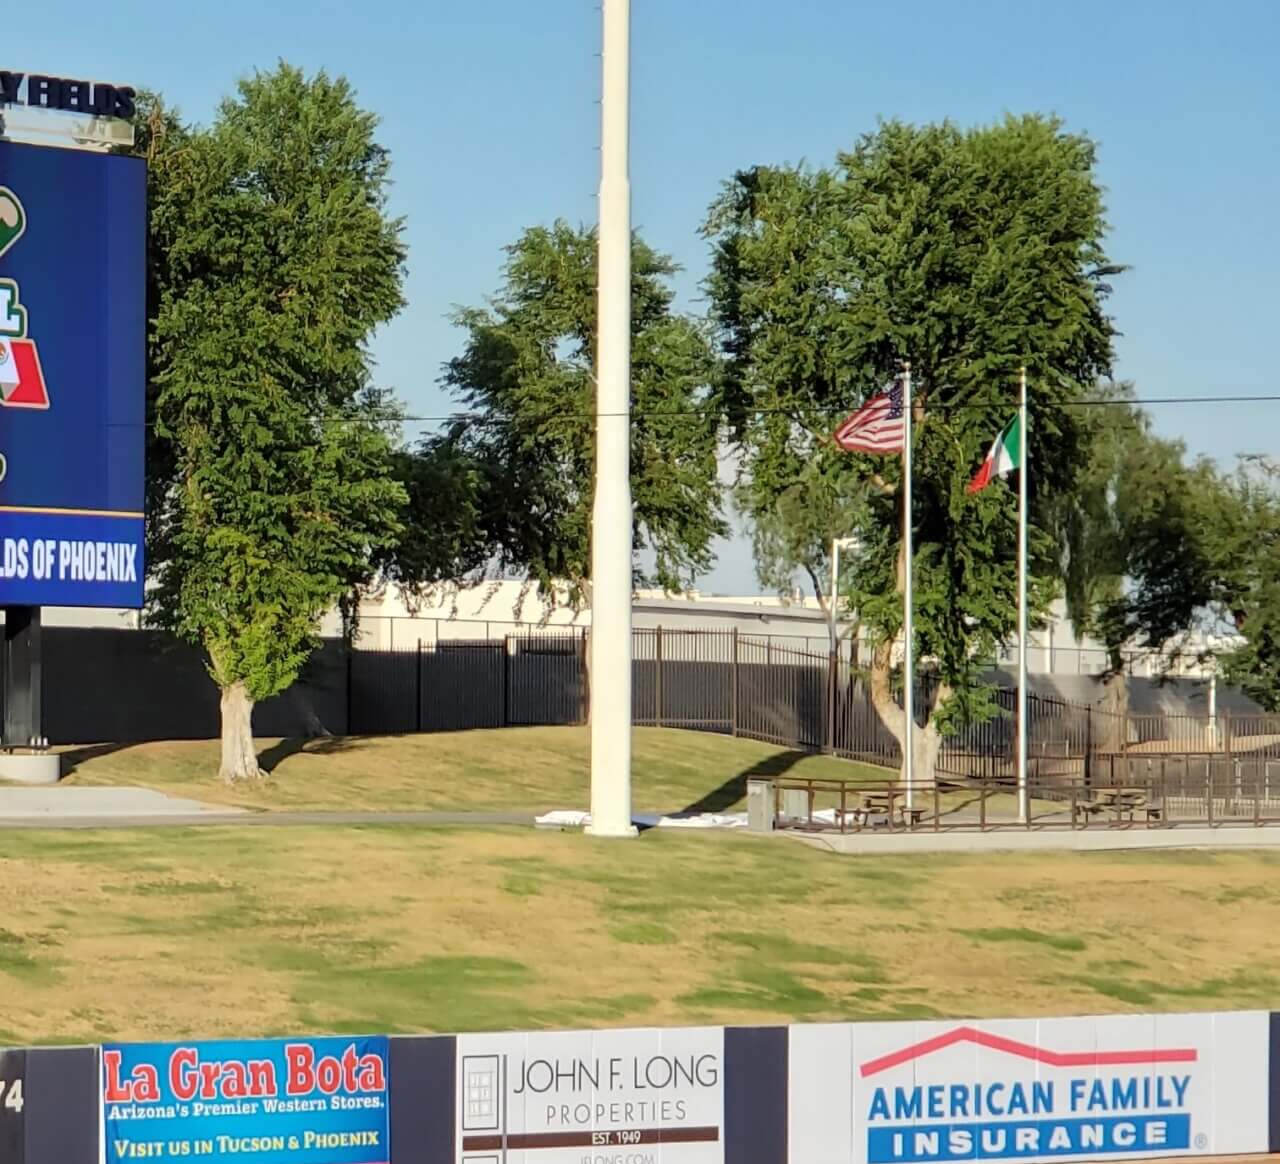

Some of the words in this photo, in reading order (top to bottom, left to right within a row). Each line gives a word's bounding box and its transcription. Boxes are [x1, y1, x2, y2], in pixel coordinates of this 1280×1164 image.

[28, 75, 136, 118] FIELDS
[32, 538, 57, 580] OF
[59, 540, 138, 583] PHOENIX
[103, 1050, 161, 1104] La
[169, 1047, 276, 1101] Gran
[284, 1042, 386, 1096] Bota
[513, 1057, 600, 1094] JOHN
[609, 1058, 624, 1090] F.
[633, 1054, 718, 1089] LONG
[108, 1103, 189, 1121] Arizona's
[192, 1101, 259, 1117] Premier
[263, 1097, 327, 1114] Western
[330, 1095, 385, 1109] Stores.
[546, 1100, 687, 1126] PROPERTIES
[867, 1080, 1055, 1122] AMERICAN
[1069, 1075, 1191, 1112] FAMILY
[287, 1136, 299, 1149] &
[591, 1132, 613, 1145] EST.
[616, 1130, 641, 1144] 1949
[893, 1121, 1168, 1157] INSURANCE
